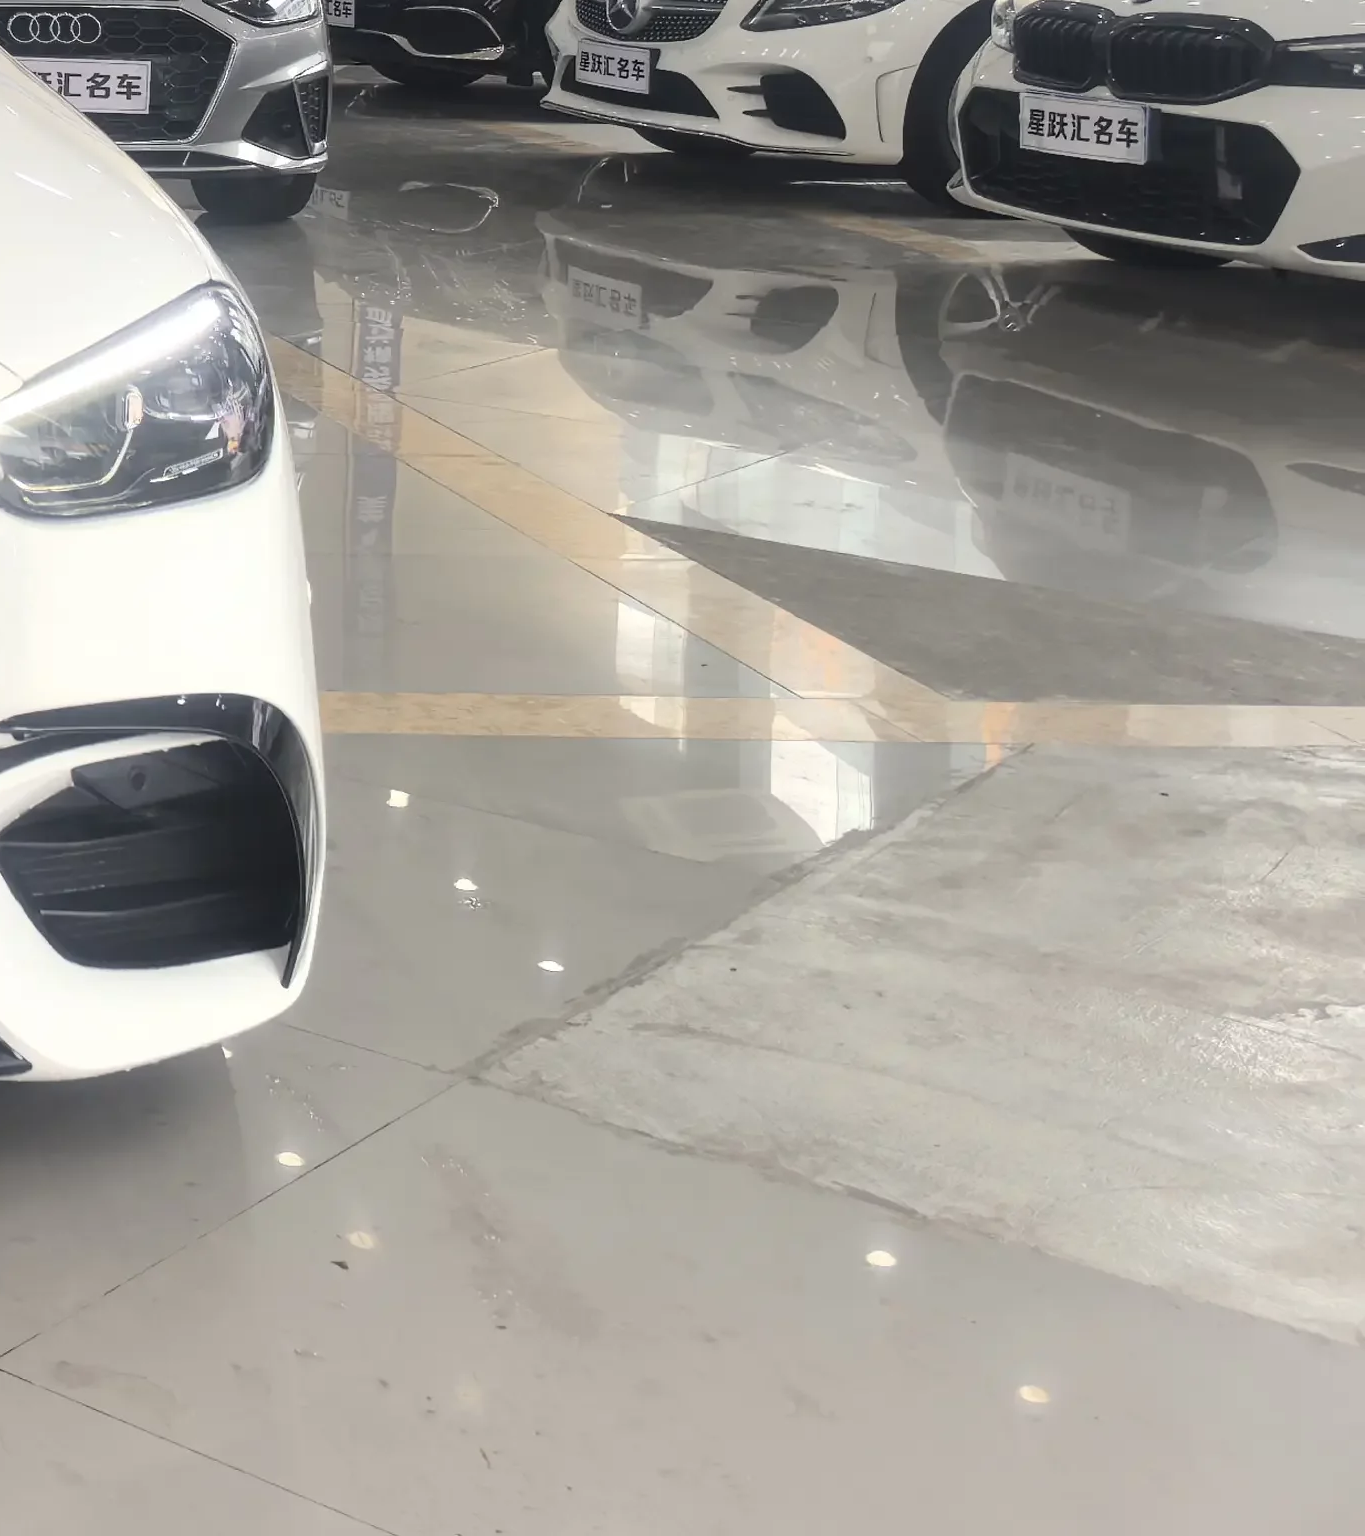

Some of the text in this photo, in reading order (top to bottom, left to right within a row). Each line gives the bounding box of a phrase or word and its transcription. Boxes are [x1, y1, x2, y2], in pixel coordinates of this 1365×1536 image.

[579, 50, 645, 81] 星跃汇名车
[1027, 108, 1139, 149] 星跃汇名车
